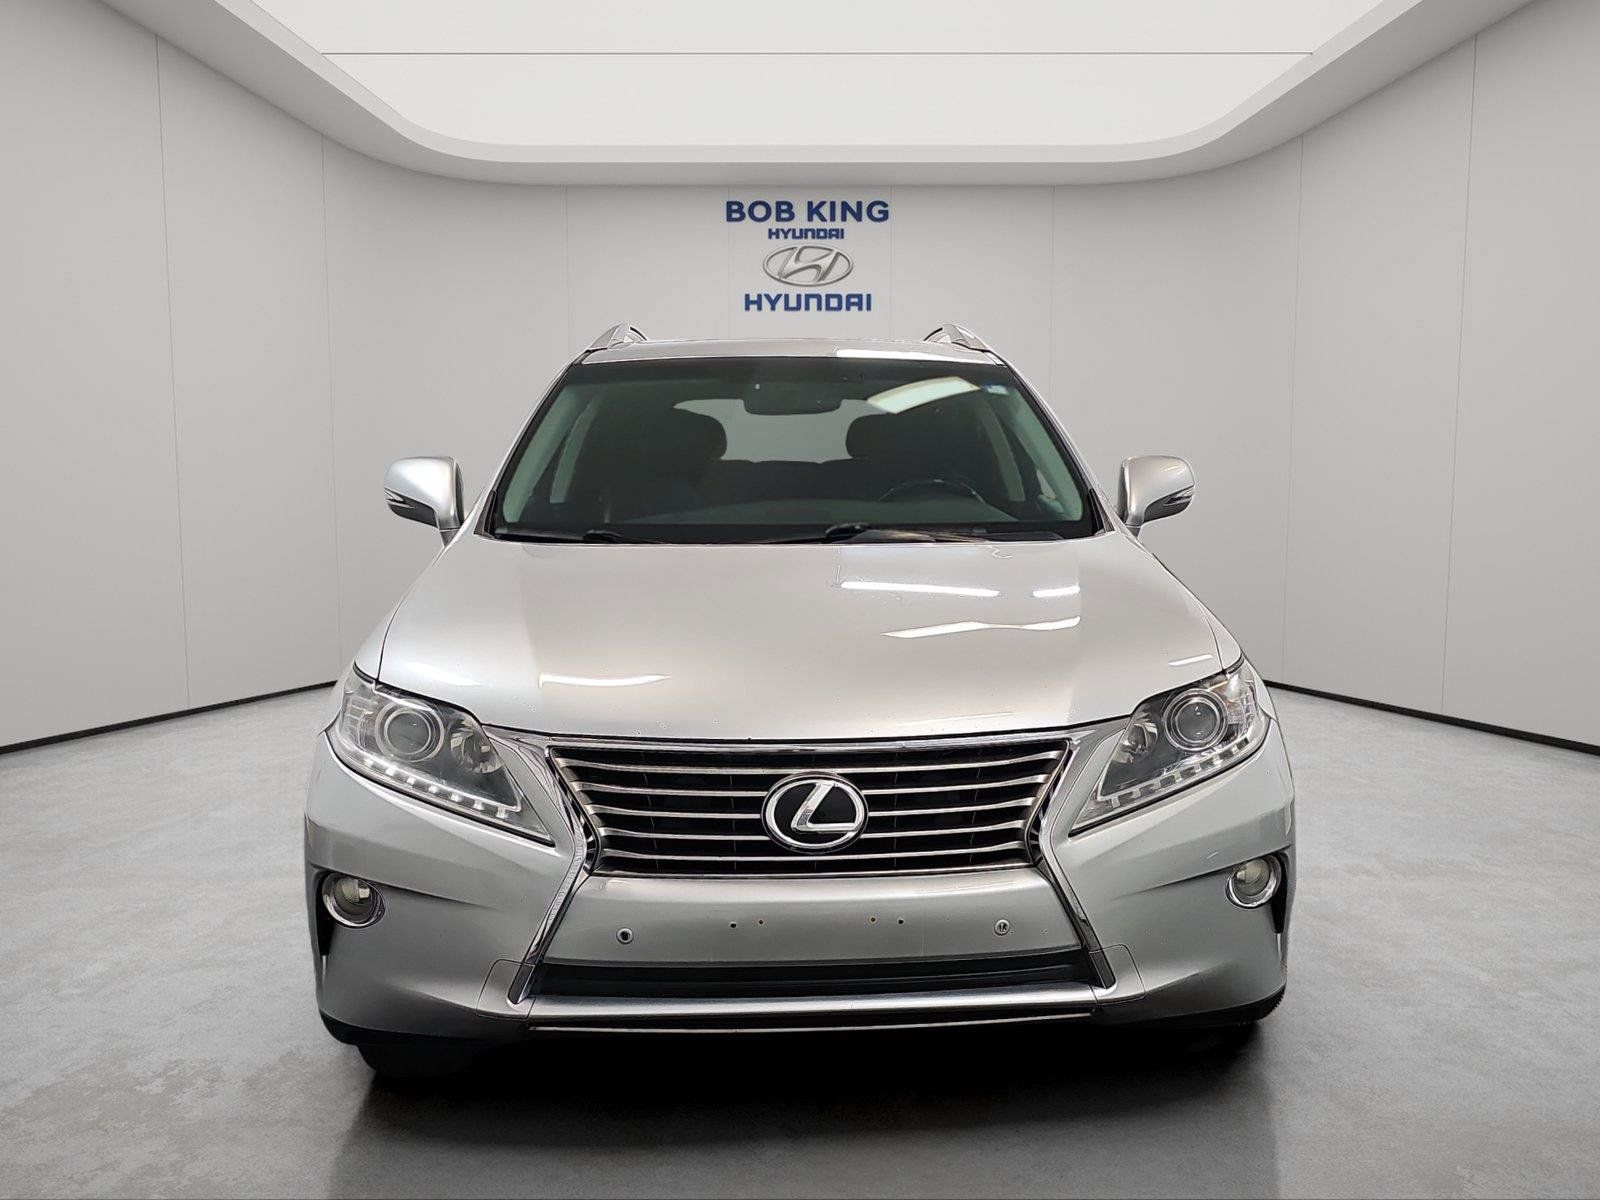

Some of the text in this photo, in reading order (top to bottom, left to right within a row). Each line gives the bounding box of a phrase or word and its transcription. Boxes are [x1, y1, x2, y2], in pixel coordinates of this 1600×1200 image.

[726, 200, 889, 222] BOB KING
[768, 228, 844, 239] HYUNDAI
[744, 293, 872, 312] HYUNDAI
